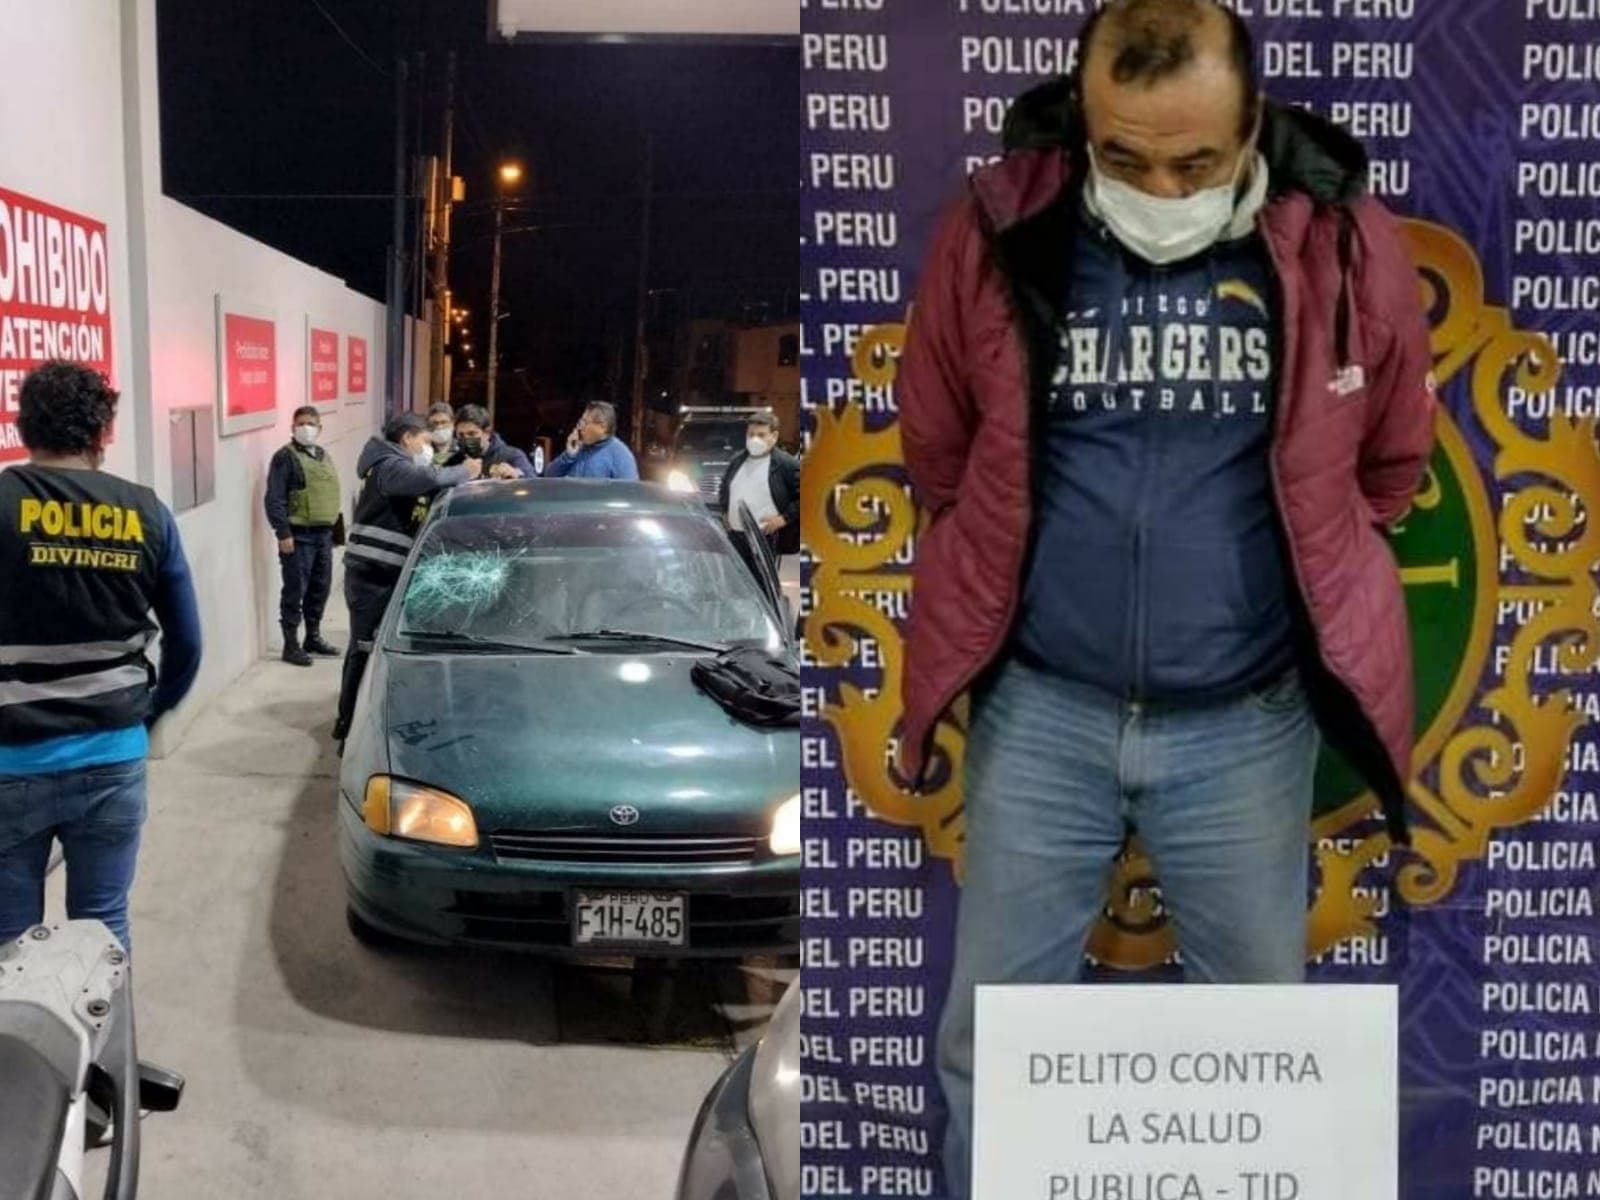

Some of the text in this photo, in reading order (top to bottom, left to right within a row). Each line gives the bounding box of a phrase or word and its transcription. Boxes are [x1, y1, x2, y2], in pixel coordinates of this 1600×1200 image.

[803, 34, 887, 71] PERU
[1263, 41, 1323, 78] DEL
[1332, 42, 1414, 79] PERU
[807, 93, 891, 132] PERU
[1331, 102, 1412, 138] PERU
[811, 153, 894, 189] PERU
[815, 211, 897, 247] PERU
[819, 268, 900, 303] PERU
[1513, 275, 1600, 310] POLIC
[0, 315, 104, 362] ATENCIÓN
[20, 498, 145, 543] POLICIA
[31, 546, 139, 571] DIVINCRI
[800, 838, 922, 869] EL PERU
[1488, 840, 1596, 871] POLICIA
[800, 887, 924, 919] EL PERU
[1485, 887, 1594, 918] POLICIA
[577, 905, 682, 938] F1H-485
[849, 937, 924, 969] PERU
[1483, 934, 1592, 965] POLICIA
[850, 985, 925, 1018] PERU
[1482, 981, 1591, 1014] POLICIA
[851, 1035, 925, 1067] PERU
[1481, 1029, 1588, 1061] POLICIA
[1029, 1052, 1323, 1085] DELITO CONTRA
[800, 1073, 925, 1115] DEL PERU
[1480, 1074, 1584, 1108] POLICIA
[800, 1120, 929, 1155] DEL PERU
[1087, 1112, 1262, 1145] LA SALUD
[1477, 1120, 1583, 1154] POLICIA
[801, 1163, 933, 1197] DEL PERU
[1049, 1173, 1205, 1200] PUBLICA
[1238, 1172, 1299, 1200] TID
[1474, 1166, 1580, 1200] POLICIA
